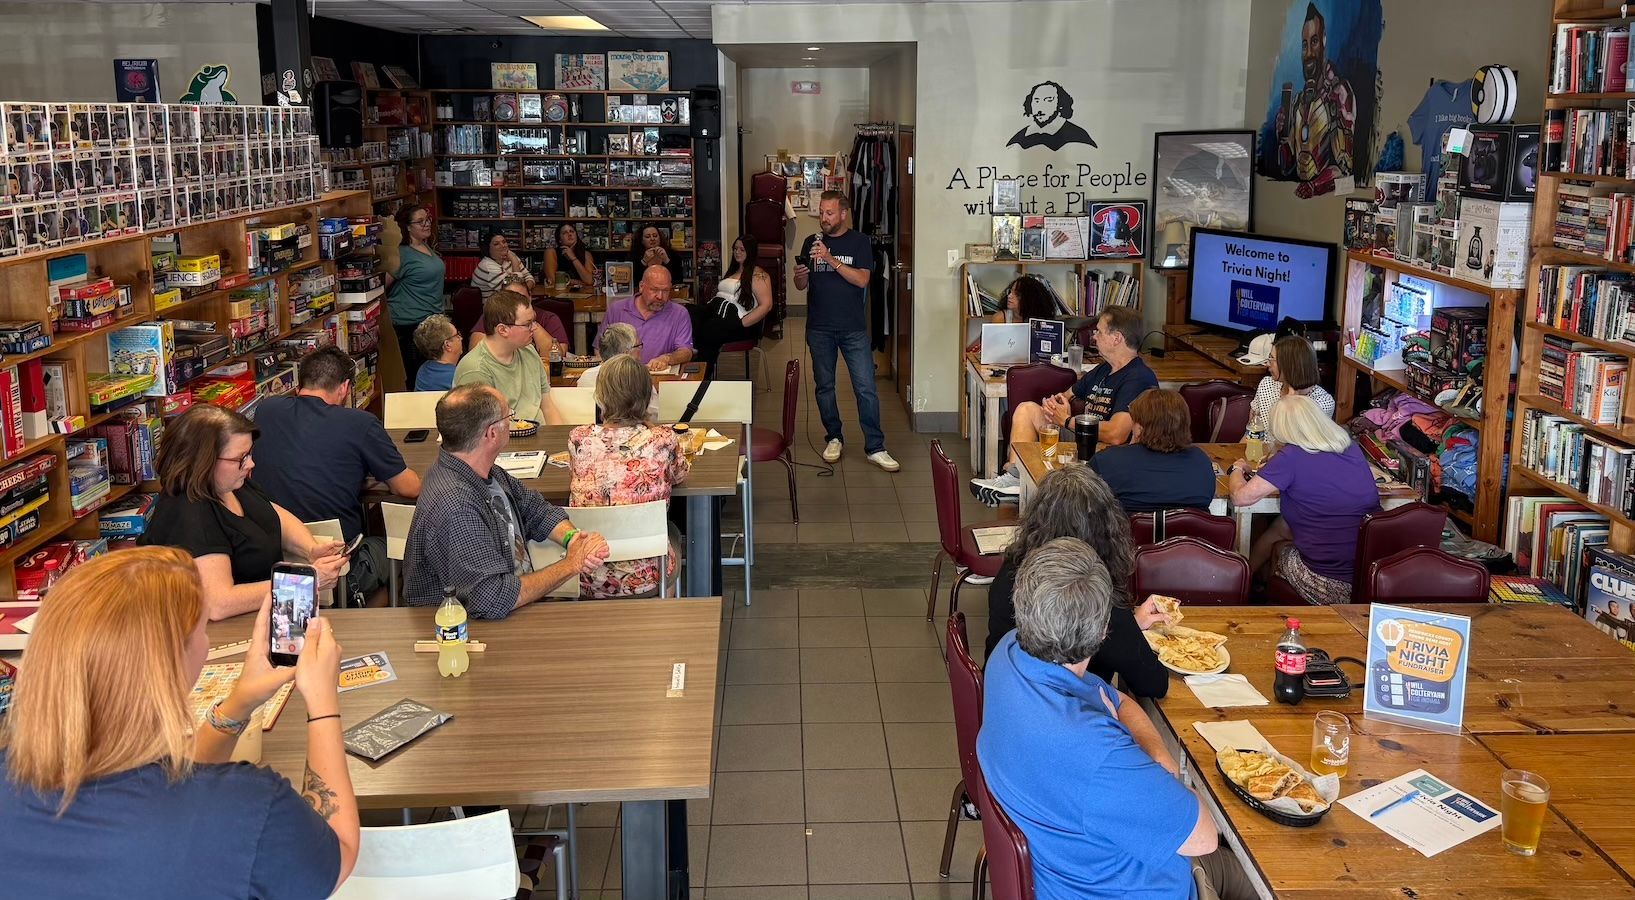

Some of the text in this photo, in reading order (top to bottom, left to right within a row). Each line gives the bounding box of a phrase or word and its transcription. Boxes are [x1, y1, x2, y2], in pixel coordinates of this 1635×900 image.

[611, 53, 632, 61] mouse
[647, 54, 665, 62] game
[946, 167, 971, 190] A
[1043, 164, 1070, 188] for
[1076, 162, 1147, 194] People
[964, 195, 1038, 216] witut
[1045, 201, 1056, 214] a
[1225, 242, 1290, 263] Welcome to
[1222, 260, 1291, 284] Trivia Night!
[1240, 287, 1254, 299] WILL
[1240, 298, 1275, 314] COLTERYAHN
[1007, 337, 1016, 348] hp
[20, 516, 36, 527] STAR
[20, 523, 36, 534] WARS
[1591, 572, 1635, 600] CLUE
[1404, 640, 1449, 658] TRIVIA
[1400, 649, 1449, 669] NIGHT
[1398, 660, 1444, 676] FUNDRAISER
[1410, 681, 1424, 690] WILL
[1410, 689, 1446, 699] COLTERYAHN
[1437, 803, 1462, 820] Night
